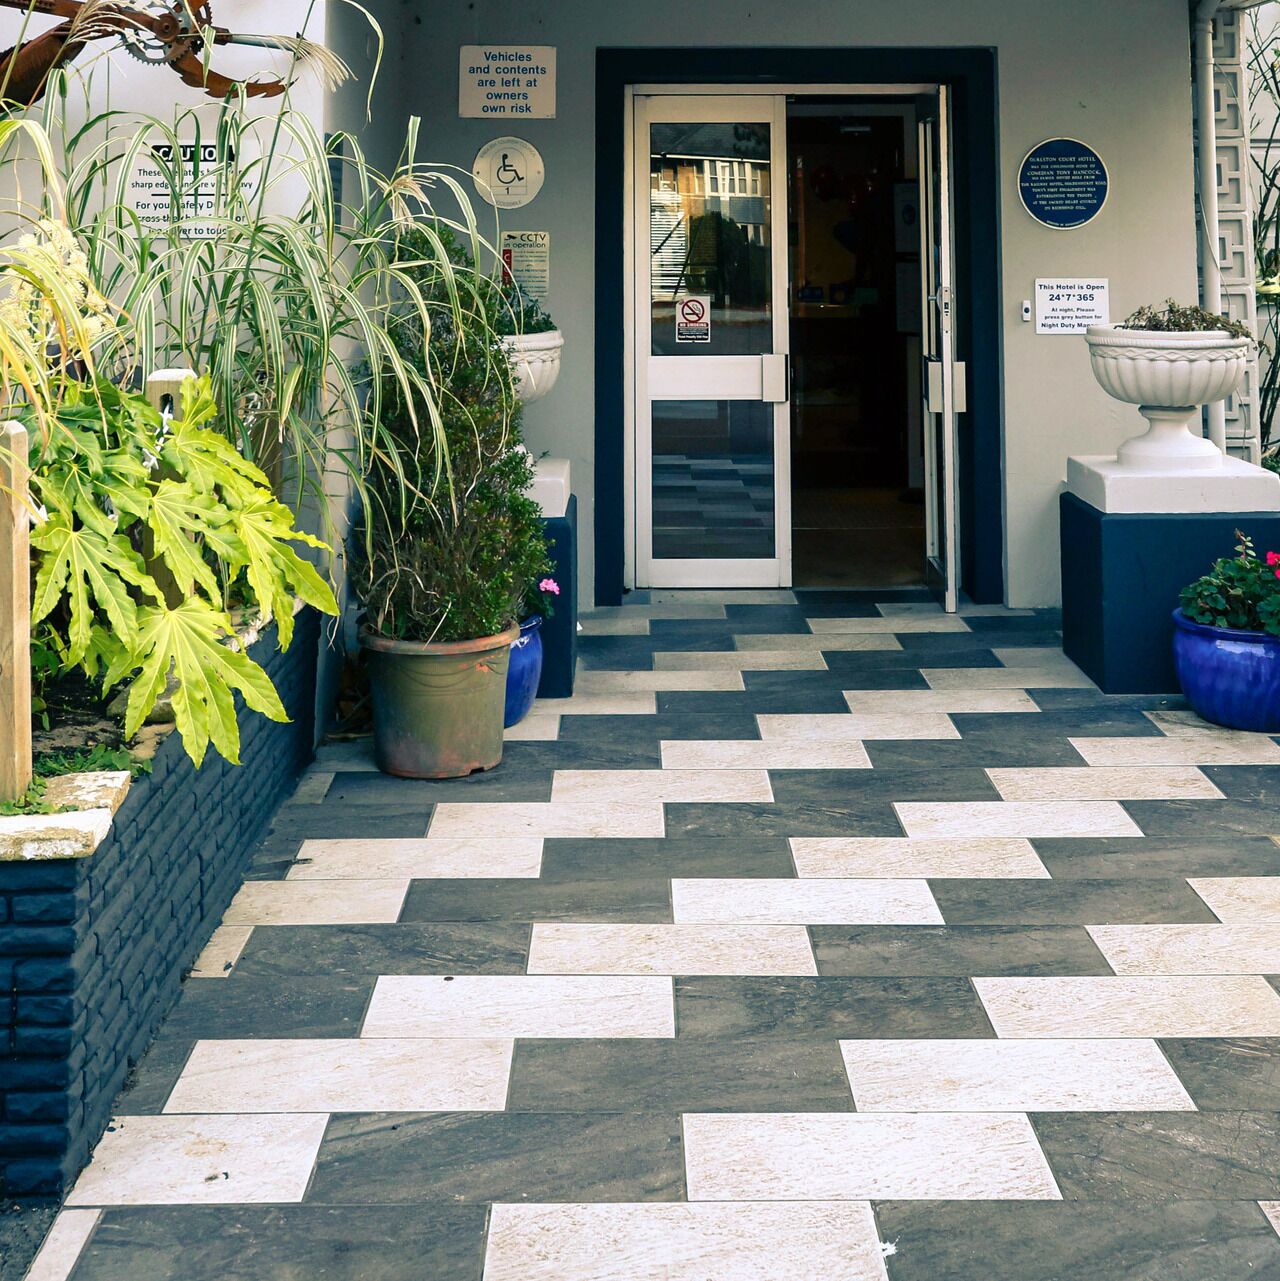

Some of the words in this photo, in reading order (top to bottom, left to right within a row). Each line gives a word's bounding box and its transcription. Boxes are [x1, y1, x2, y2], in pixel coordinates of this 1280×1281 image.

[483, 51, 532, 62] Vehicles
[468, 64, 490, 74] and
[495, 65, 547, 75] contents
[477, 79, 496, 87] are
[501, 77, 521, 87] left
[526, 78, 538, 87] at
[486, 92, 529, 100] owners
[482, 104, 506, 113] own
[510, 103, 532, 113] risk
[159, 147, 219, 161] CUIO
[131, 181, 153, 189] sharp
[504, 187, 510, 195] 1
[136, 201, 150, 209] For
[153, 202, 171, 210] you
[180, 201, 204, 211] afey
[206, 227, 227, 235] touc
[520, 233, 546, 241] CCTV
